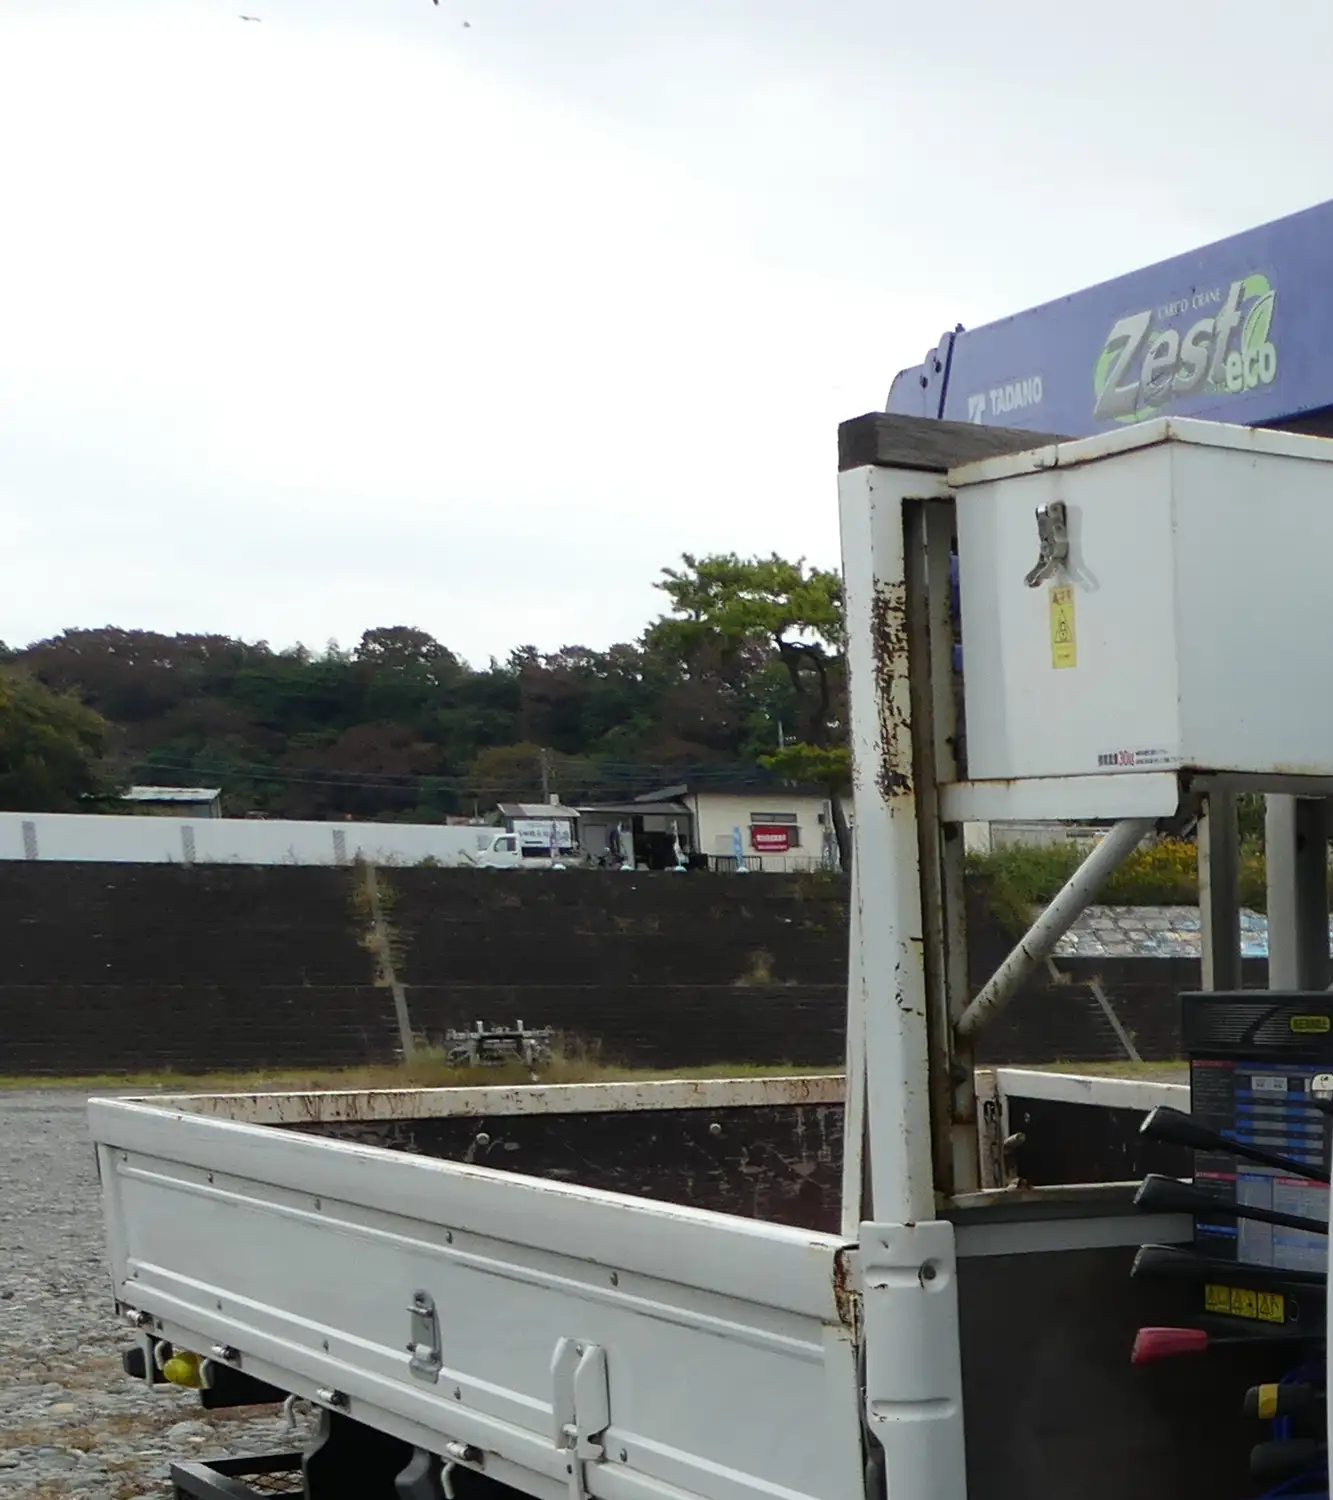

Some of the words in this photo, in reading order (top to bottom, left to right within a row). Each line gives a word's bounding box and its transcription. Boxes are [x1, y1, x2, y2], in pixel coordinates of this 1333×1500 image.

[1094, 279, 1246, 418] Zest
[1226, 343, 1277, 394] eco
[988, 375, 1043, 417] TADANO
